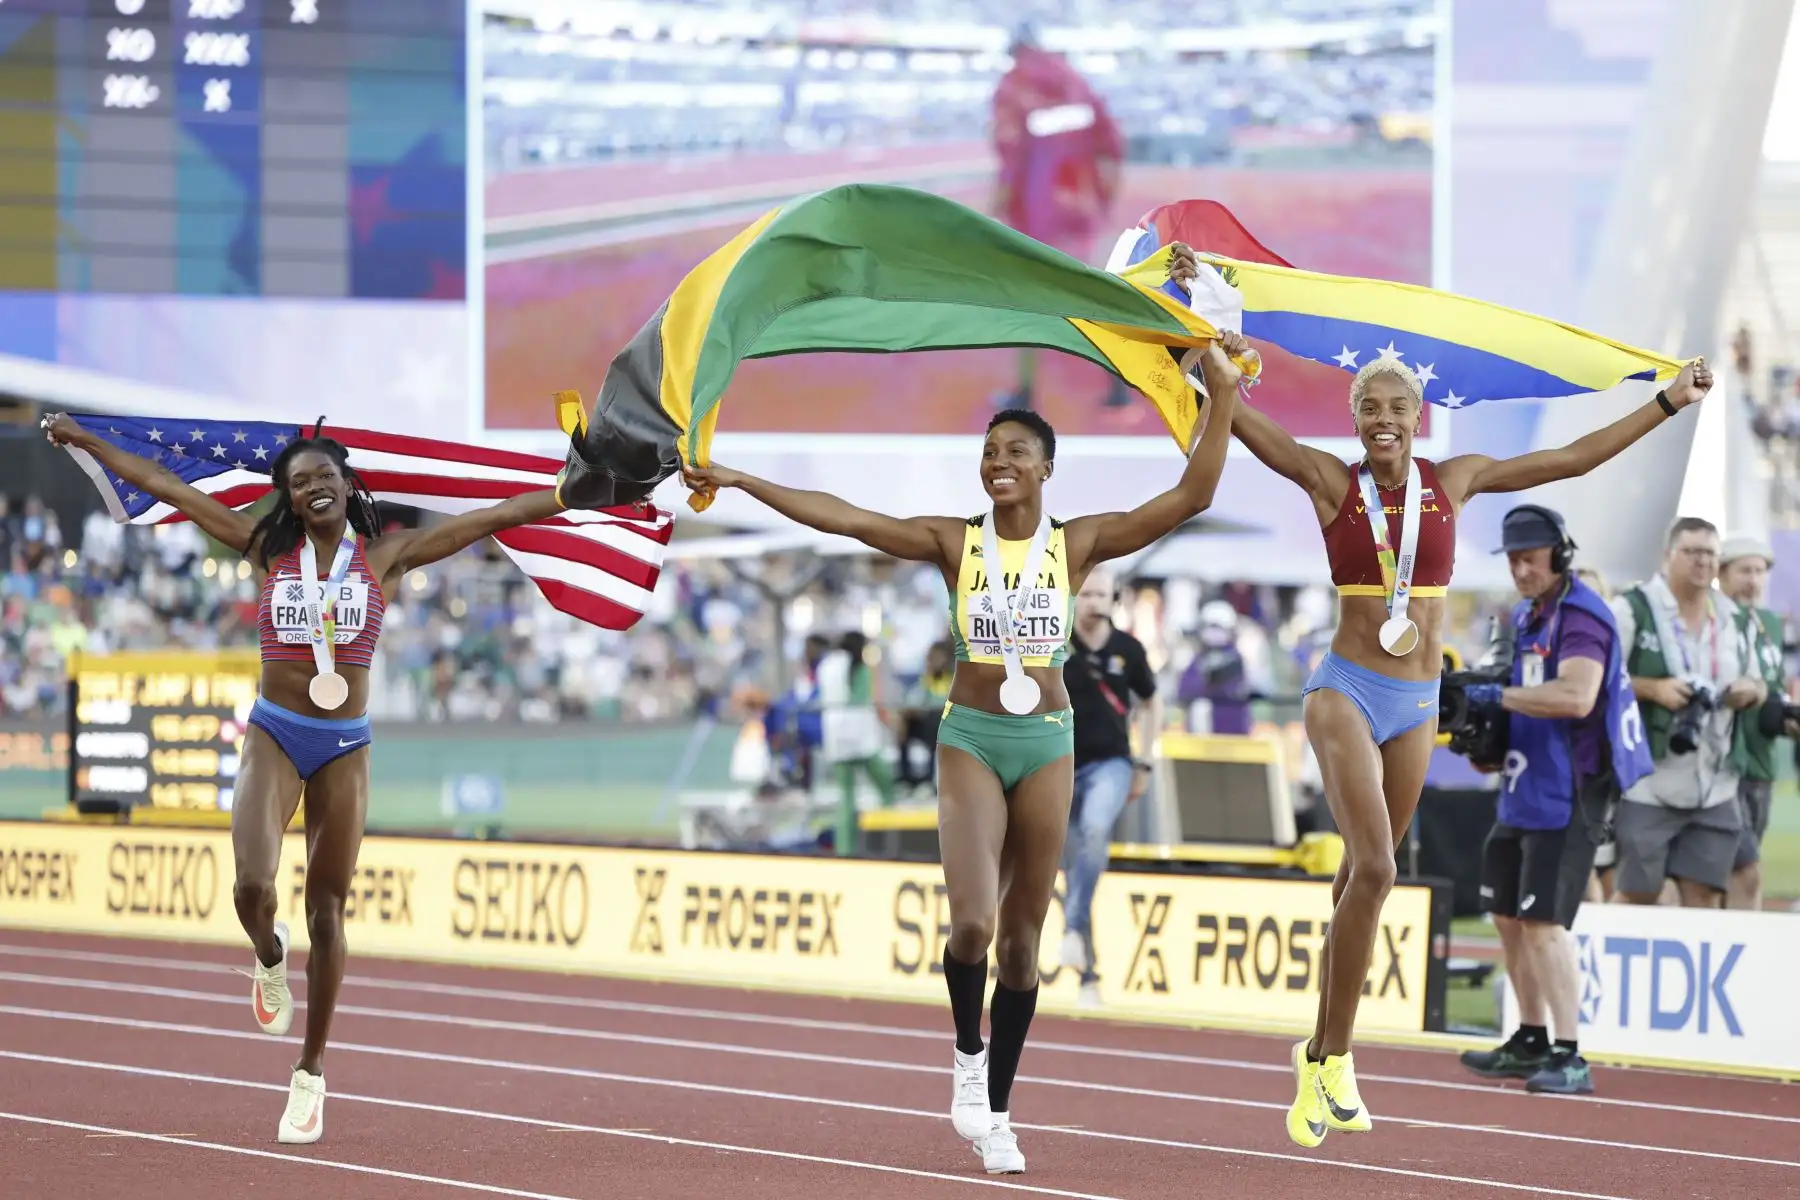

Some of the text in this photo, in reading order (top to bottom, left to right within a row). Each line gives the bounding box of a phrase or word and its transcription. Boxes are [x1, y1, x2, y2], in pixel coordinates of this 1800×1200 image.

[276, 606, 361, 626] FRALIN
[286, 632, 350, 642] ORE22
[974, 616, 1060, 638] RICETTS
[984, 645, 1051, 655] ORON22
[0, 849, 78, 904] OSPEX
[106, 841, 218, 921] SEIKO
[289, 864, 415, 926] PSPEX
[452, 858, 590, 948] SEIKO
[681, 885, 842, 957] PROSPEX
[1193, 914, 1413, 1000] PROSX
[1603, 935, 1747, 1038] TDK
